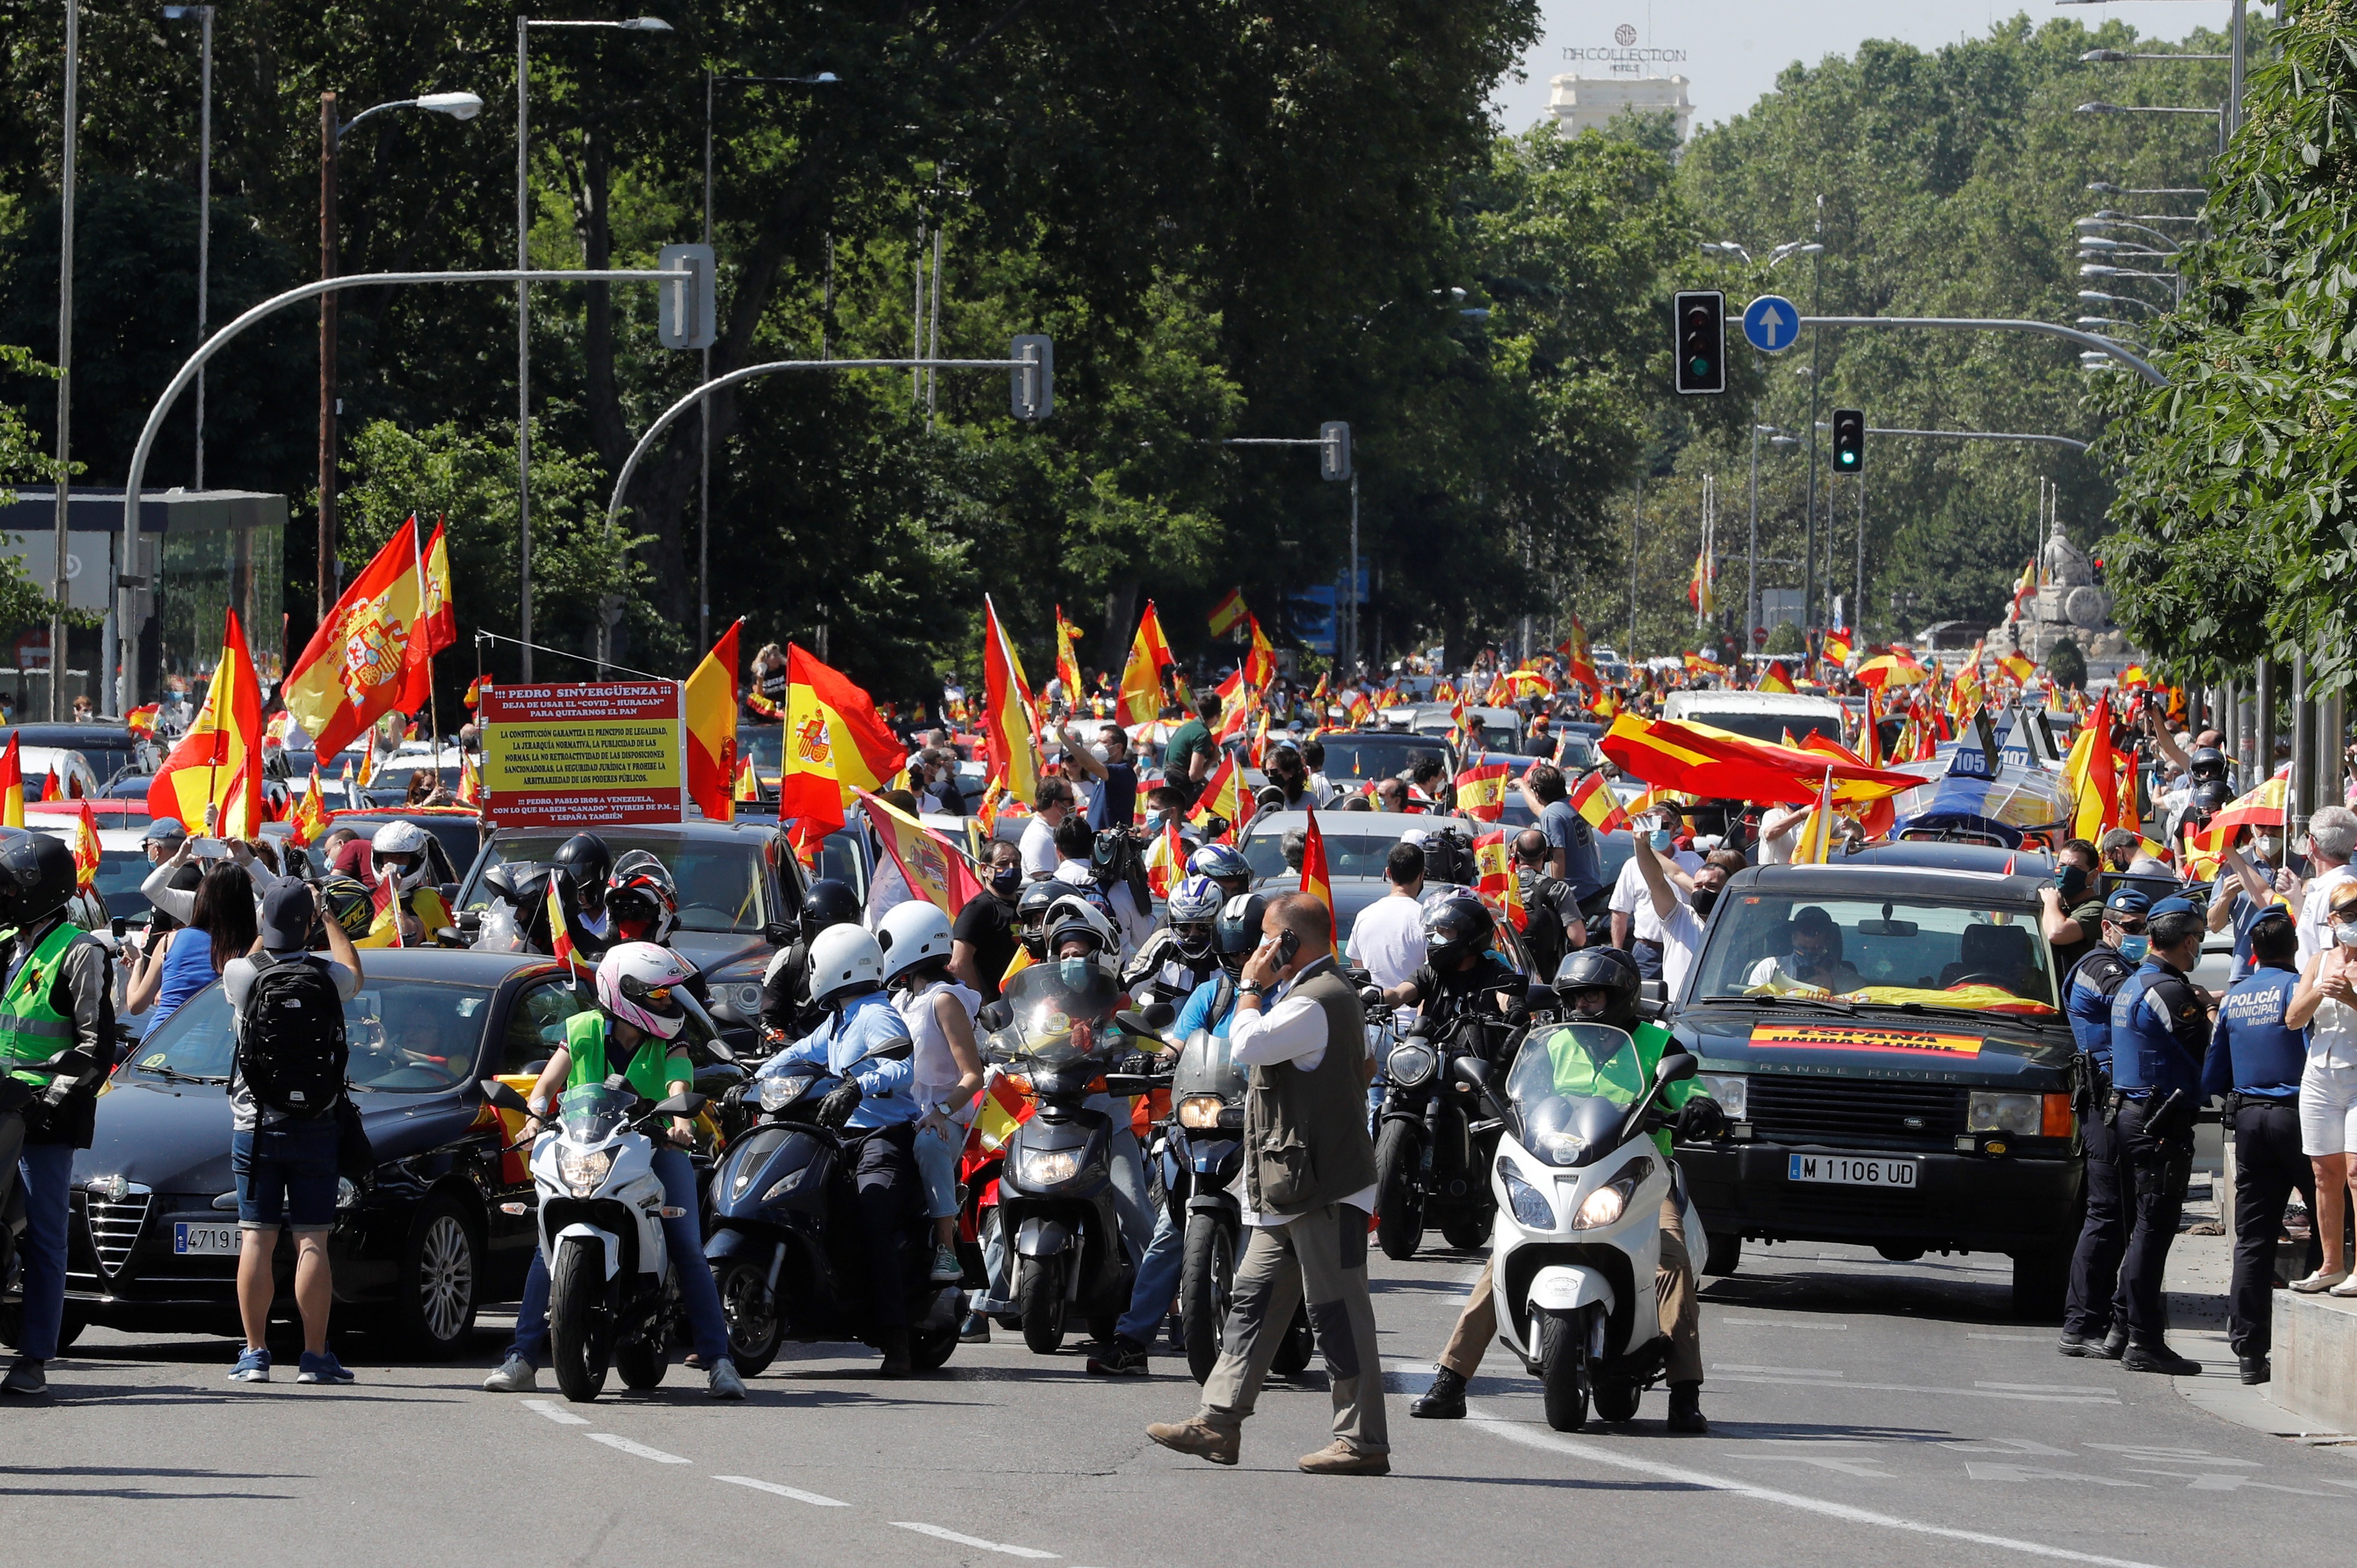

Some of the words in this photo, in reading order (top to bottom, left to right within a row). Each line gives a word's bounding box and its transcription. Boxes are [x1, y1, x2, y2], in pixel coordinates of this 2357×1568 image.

[1586, 47, 1687, 61] COLLECTION
[509, 689, 551, 698] PEDRO
[557, 685, 658, 696] SINVERGÜENZA
[556, 709, 605, 717] QUITARNOS
[509, 728, 552, 738] CONSTITUCIÓN
[553, 729, 586, 737] GARANTIZA
[596, 728, 624, 736] PRINCIPIO
[634, 727, 668, 736] LEGALIDAD,
[1993, 731, 2008, 746] 10
[522, 739, 554, 750] JERARQUÍA
[556, 741, 592, 749] NORMATIVA,
[593, 740, 600, 748] LA
[601, 739, 636, 747] PUBLICIDAD
[645, 739, 657, 747] LAS
[505, 754, 531, 763] NORMAS,
[550, 752, 600, 761] RETROACTIVIDAD
[622, 750, 665, 759] DISPOSICIONES
[1956, 752, 1985, 773] 105
[2001, 750, 2029, 766] 107
[505, 765, 554, 774] SANCIONADORAS,
[556, 764, 564, 772] LA
[565, 764, 597, 772] SEGURIDAD
[599, 761, 626, 771] JURÍDICA
[628, 763, 632, 771] Y
[633, 762, 657, 770] PROHIBE
[524, 776, 571, 785] ARBITRARIEDAD
[581, 775, 590, 783] LOS
[592, 775, 618, 783] PODERES
[619, 772, 648, 782] PÚBLICOS.
[558, 812, 588, 821] ESPAÑA
[589, 812, 623, 820] TAMBIÉN
[339, 904, 365, 928] HIRO
[2228, 986, 2280, 1008] POLICÍA
[2228, 1003, 2279, 1019] MUNICIPAL
[2247, 1014, 2279, 1026] Madrid
[1760, 1064, 1848, 1075] RANGE
[1868, 1069, 1957, 1080] ROVER
[1803, 1158, 1816, 1178] M
[1827, 1160, 1879, 1182] 1106
[1888, 1164, 1913, 1184] UD
[187, 1229, 229, 1248] 4719
[1723, 1453, 2357, 1498] TAX
